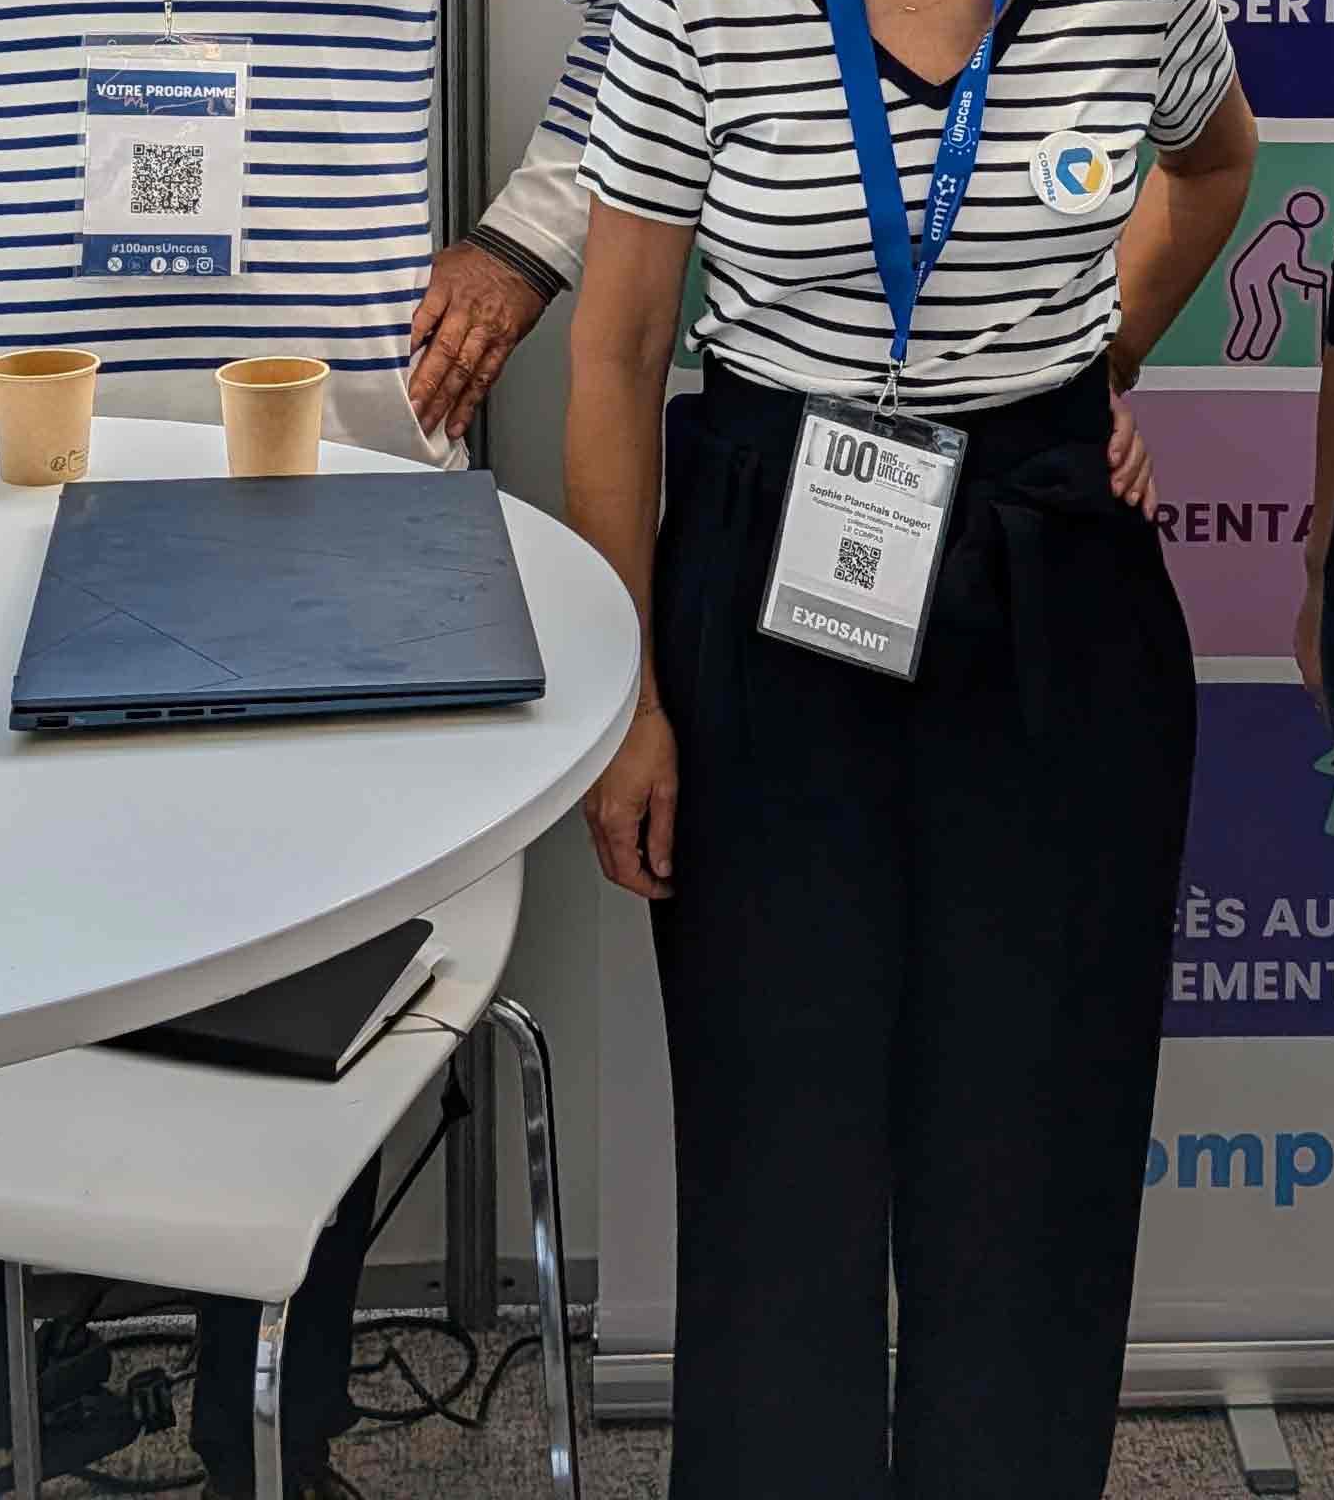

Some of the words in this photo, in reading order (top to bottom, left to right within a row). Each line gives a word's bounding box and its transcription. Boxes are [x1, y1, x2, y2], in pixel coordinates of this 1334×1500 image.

[96, 83, 143, 97] VOTRE
[146, 84, 237, 99] PROGRAMME
[952, 90, 973, 142] unccas
[1037, 150, 1059, 204] compas
[931, 194, 951, 241] amf
[111, 243, 208, 255] #100ansUnccas
[824, 429, 880, 484] 100
[876, 461, 921, 490] UNCCAS
[809, 483, 843, 502] Sophie
[844, 494, 891, 517] Planchais
[892, 510, 932, 531] Drugeot
[791, 605, 891, 652] EXPOSANT
